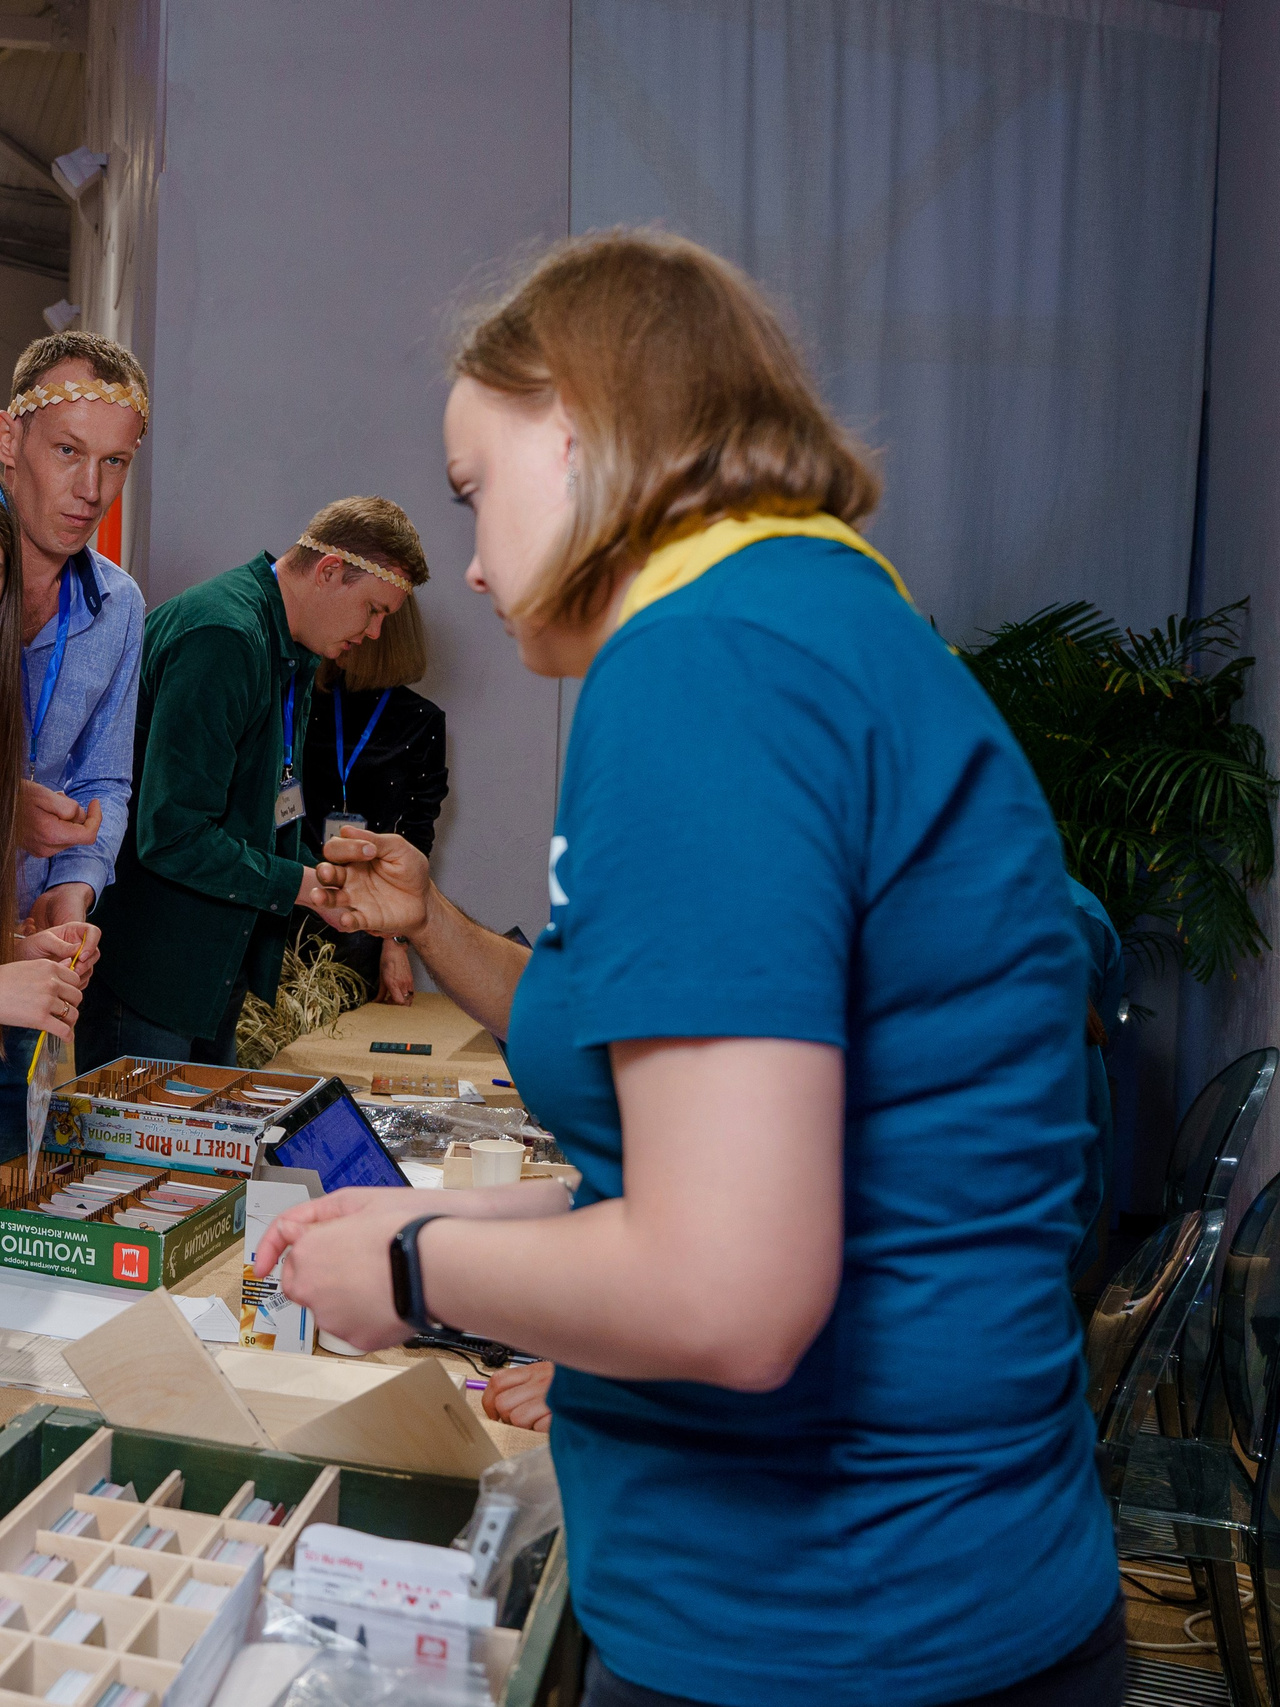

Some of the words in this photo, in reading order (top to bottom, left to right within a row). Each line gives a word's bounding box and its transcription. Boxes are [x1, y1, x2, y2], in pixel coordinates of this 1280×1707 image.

[88, 1128, 132, 1145] ЕВРОПА
[135, 1131, 172, 1157] RIDE
[176, 1139, 191, 1152] TO
[193, 1139, 253, 1166] TICKET
[184, 1213, 232, 1260] ЭВОЛЮЦИЯ
[30, 1260, 59, 1272] Дмитрия
[61, 1265, 77, 1275] Игра
[244, 1336, 256, 1345] 50
